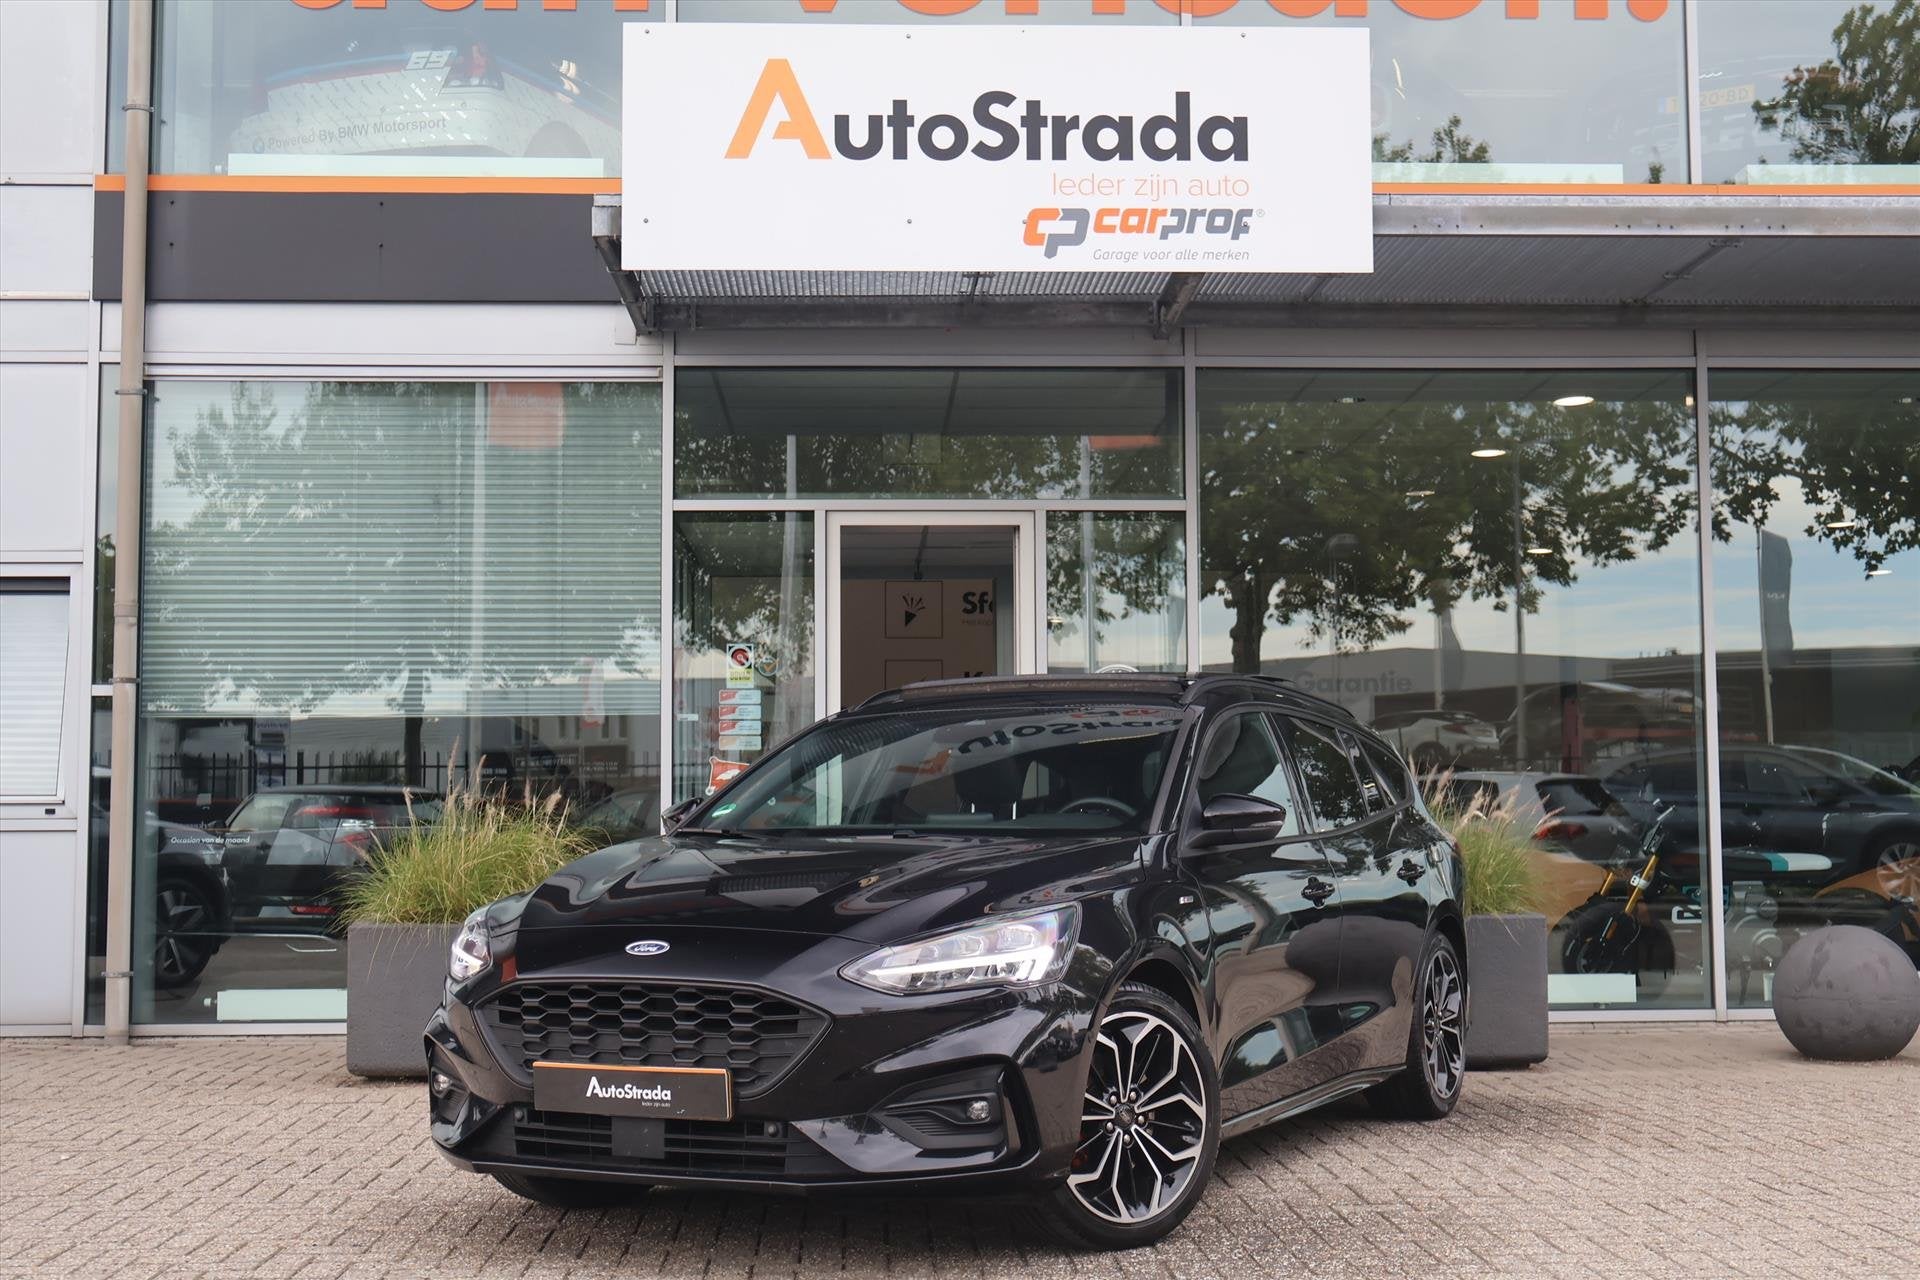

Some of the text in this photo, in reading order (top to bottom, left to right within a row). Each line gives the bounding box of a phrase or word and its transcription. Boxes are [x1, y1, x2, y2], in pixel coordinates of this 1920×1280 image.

[723, 58, 1250, 162] AutoStrada
[267, 117, 447, 150] Powered By BMW Motorsport
[1134, 173, 1179, 201] zijn
[1188, 175, 1250, 197] auto
[1092, 248, 1250, 263] Garage voor alle merken
[1296, 669, 1413, 693] Garantie
[170, 836, 200, 845] Occasion
[215, 836, 225, 844] de
[225, 835, 250, 844] maand
[586, 1076, 671, 1101] AutoStrada
